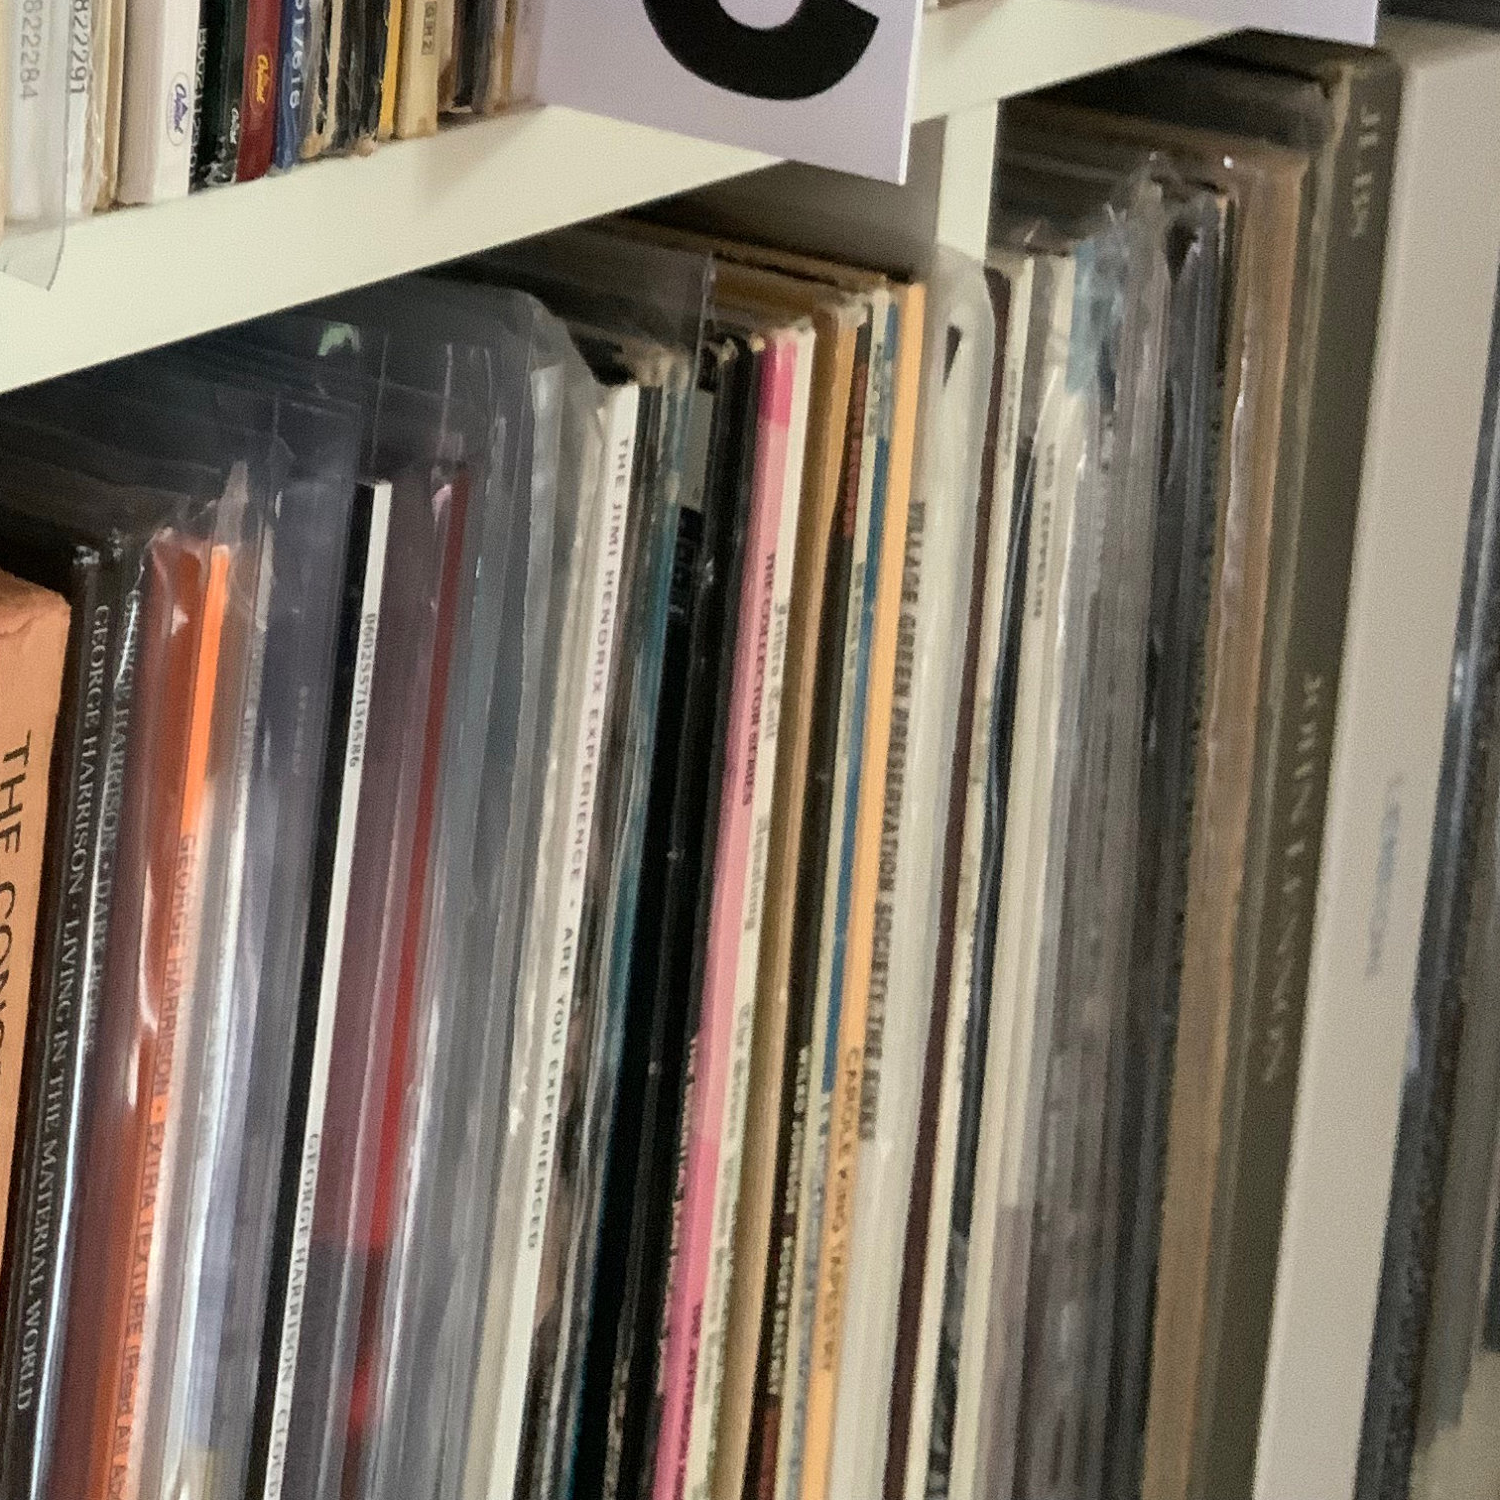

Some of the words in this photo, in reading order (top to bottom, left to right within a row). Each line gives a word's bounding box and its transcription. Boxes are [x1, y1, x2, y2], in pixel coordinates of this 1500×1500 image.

[615, 439, 629, 484] THE
[608, 504, 622, 556] JIMI
[84, 605, 110, 728] GEORGE
[593, 570, 615, 693] HENDRIX
[67, 736, 99, 895] HARRISON
[571, 709, 599, 879] EXPERIENCE
[53, 920, 81, 1021] LIVING
[560, 928, 574, 974] ARE
[45, 1074, 66, 1126] THE
[49, 1030, 69, 1065] IN
[29, 1140, 59, 1295] MATERIAL
[17, 1300, 42, 1410] WORLD
